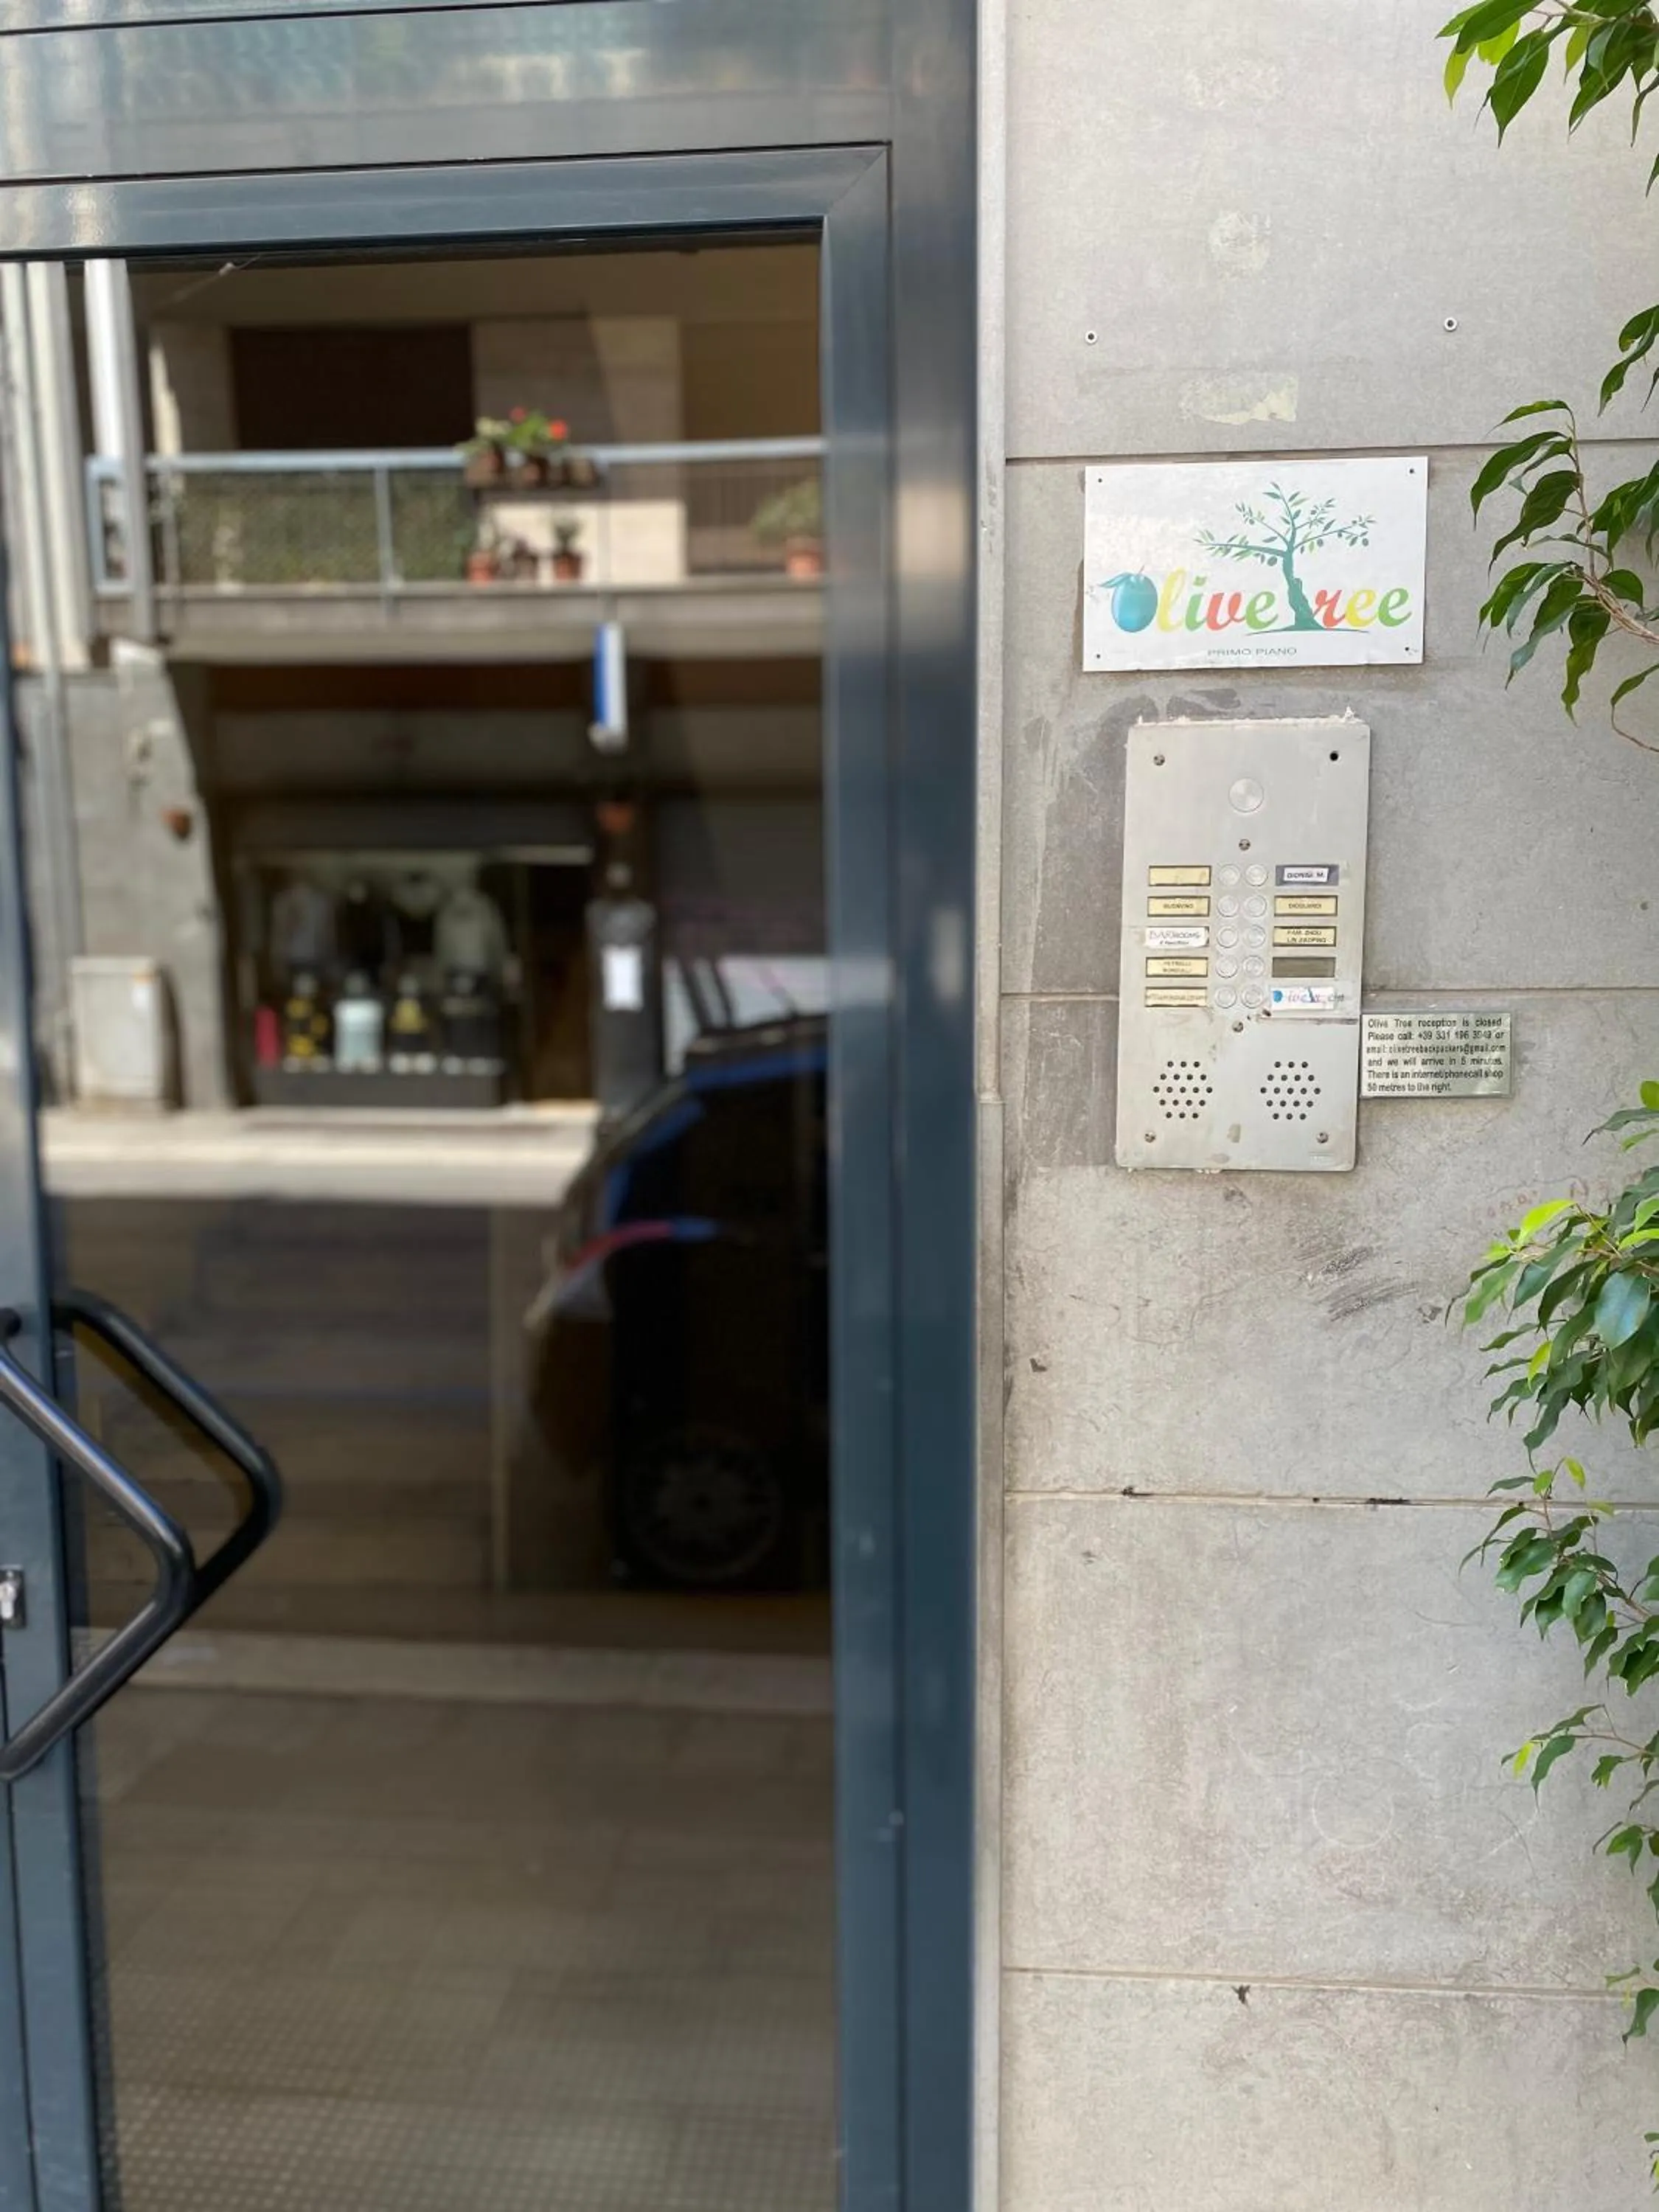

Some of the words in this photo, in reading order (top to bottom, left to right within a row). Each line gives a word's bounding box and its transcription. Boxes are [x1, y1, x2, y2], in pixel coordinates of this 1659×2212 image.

[1207, 648, 1252, 656] PRIMO
[1256, 647, 1298, 656] PIANO
[1368, 1018, 1388, 1028] Olive
[1394, 1018, 1412, 1027] Tree
[1418, 1018, 1457, 1029] reception
[1462, 1018, 1470, 1027] is
[1475, 1018, 1502, 1027] closed
[1368, 1032, 1394, 1040] Please
[1368, 1057, 1382, 1067] and
[1387, 1058, 1399, 1066] we
[1403, 1057, 1416, 1066] will
[1421, 1057, 1444, 1066] arrive
[1449, 1057, 1456, 1065] in
[1368, 1070, 1389, 1079] There
[1392, 1070, 1398, 1079] is
[1378, 1083, 1406, 1092] metres
[1408, 1082, 1416, 1092] to
[1416, 1082, 1430, 1092] the
